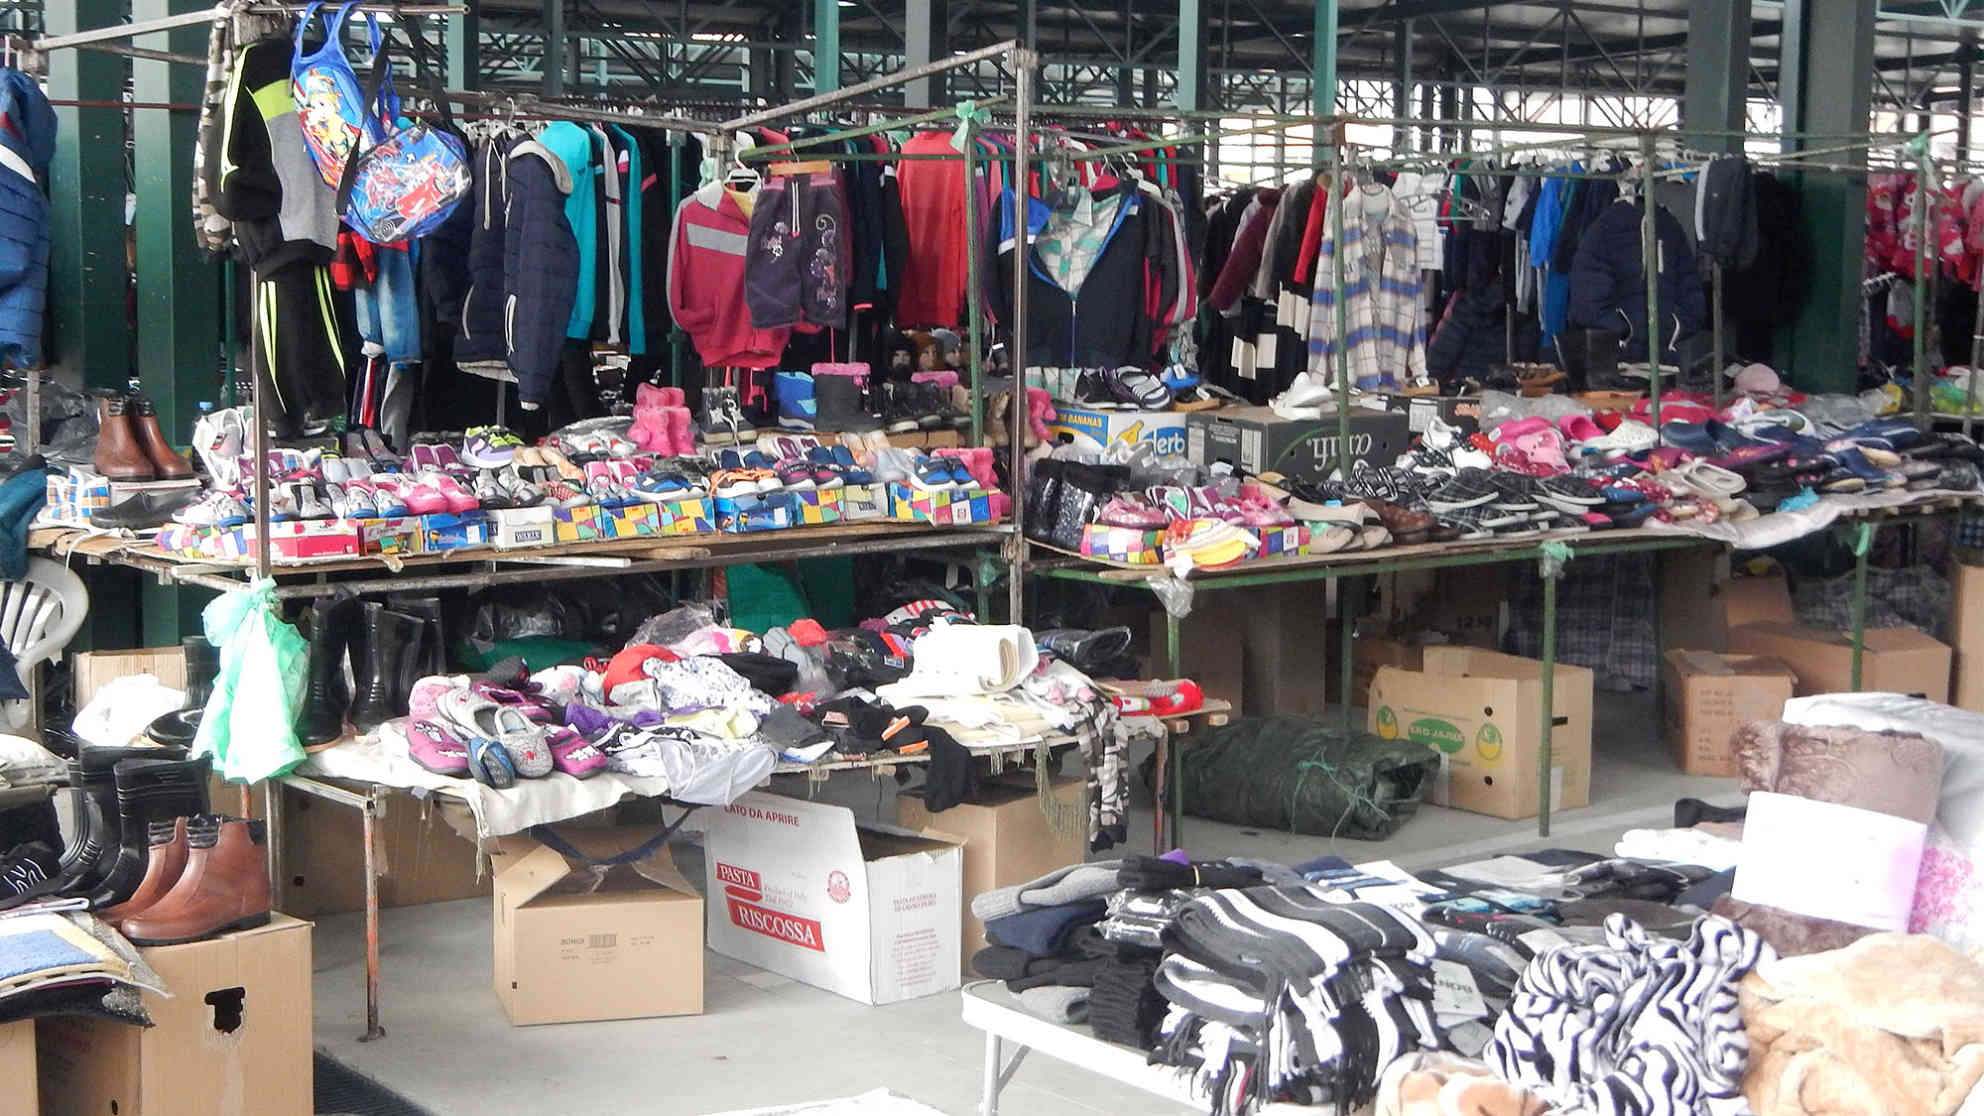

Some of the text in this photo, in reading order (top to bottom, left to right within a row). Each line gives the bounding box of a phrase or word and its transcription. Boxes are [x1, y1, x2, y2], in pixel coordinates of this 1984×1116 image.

[750, 809, 763, 820] DA
[766, 811, 800, 827] APRIRE
[719, 865, 755, 887] PASTA
[737, 905, 816, 946] RISCOSSA
